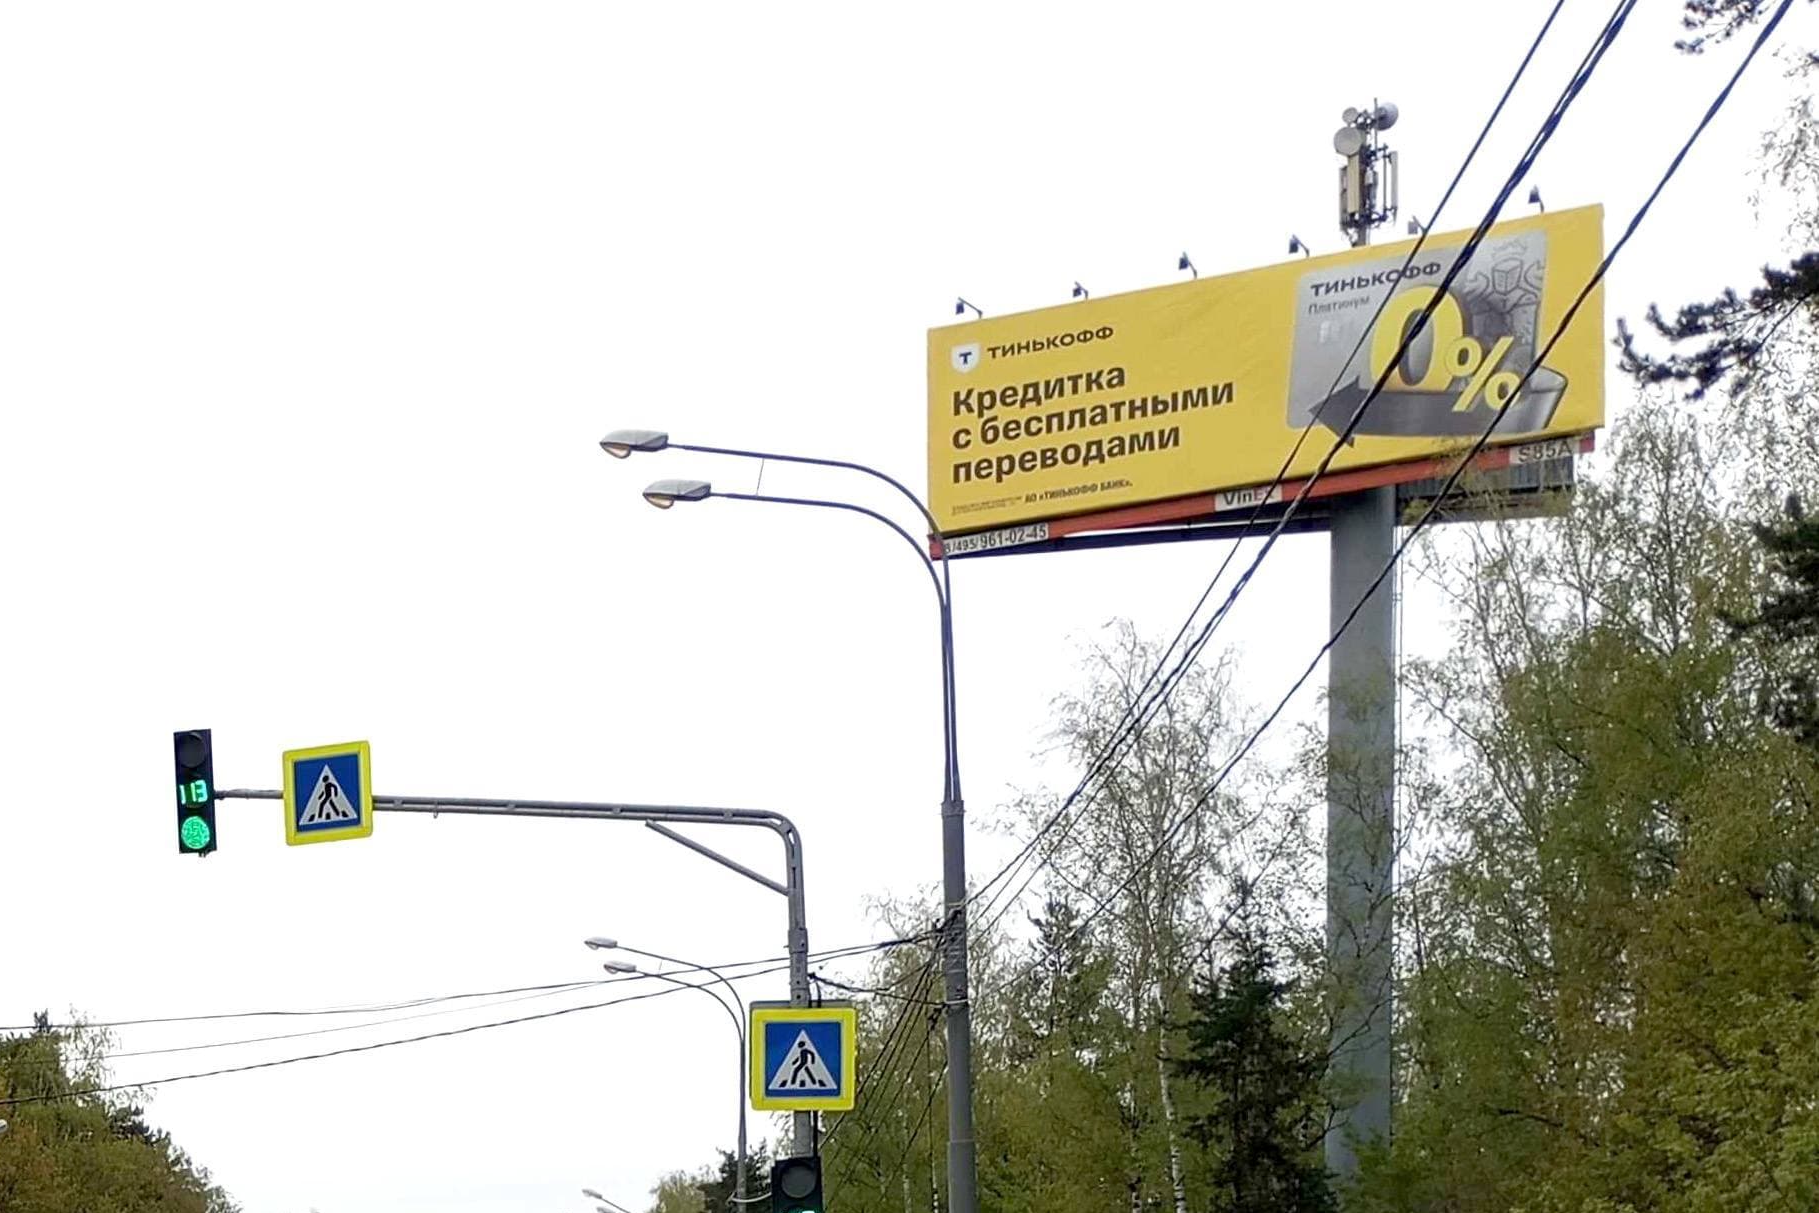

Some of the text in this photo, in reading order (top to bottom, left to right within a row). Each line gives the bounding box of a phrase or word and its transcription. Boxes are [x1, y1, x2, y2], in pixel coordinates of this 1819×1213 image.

[1310, 261, 1442, 297] ТИНЬКОФФ
[986, 326, 1114, 359] ТИНЬКОФФ
[1369, 285, 1522, 413] 0%
[952, 366, 1126, 419] Кредитка
[952, 381, 1234, 450] с бесплатными
[952, 425, 1181, 485] переводами
